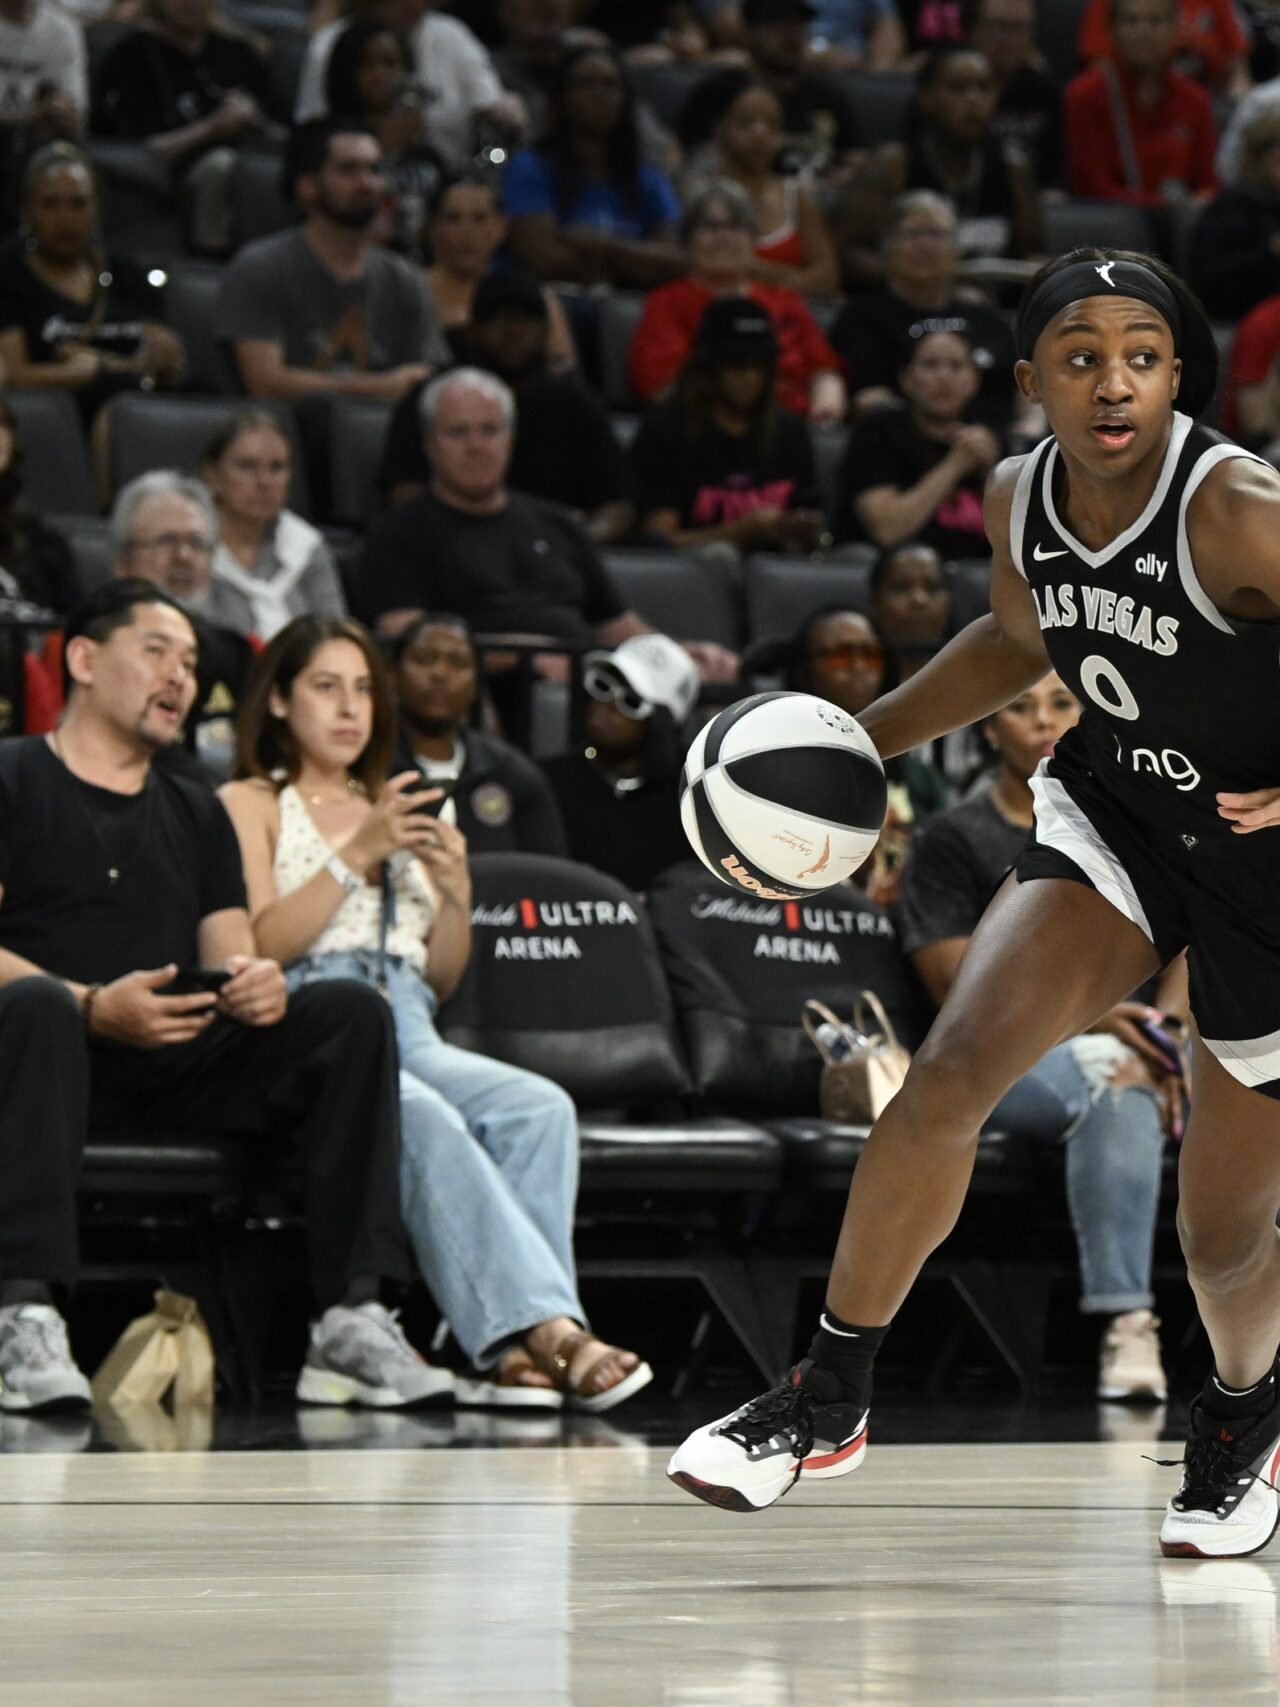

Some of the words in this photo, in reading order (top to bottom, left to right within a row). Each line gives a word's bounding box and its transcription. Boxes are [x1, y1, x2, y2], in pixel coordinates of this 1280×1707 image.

[1135, 553, 1168, 582] ally
[1031, 583, 1078, 631] LAS
[1081, 585, 1180, 656] VEGAS
[1080, 654, 1140, 721] 0
[539, 900, 638, 927] ULTRA
[803, 906, 896, 939] ULTRA
[495, 936, 582, 960] ARENA
[754, 934, 840, 964] ARENA
